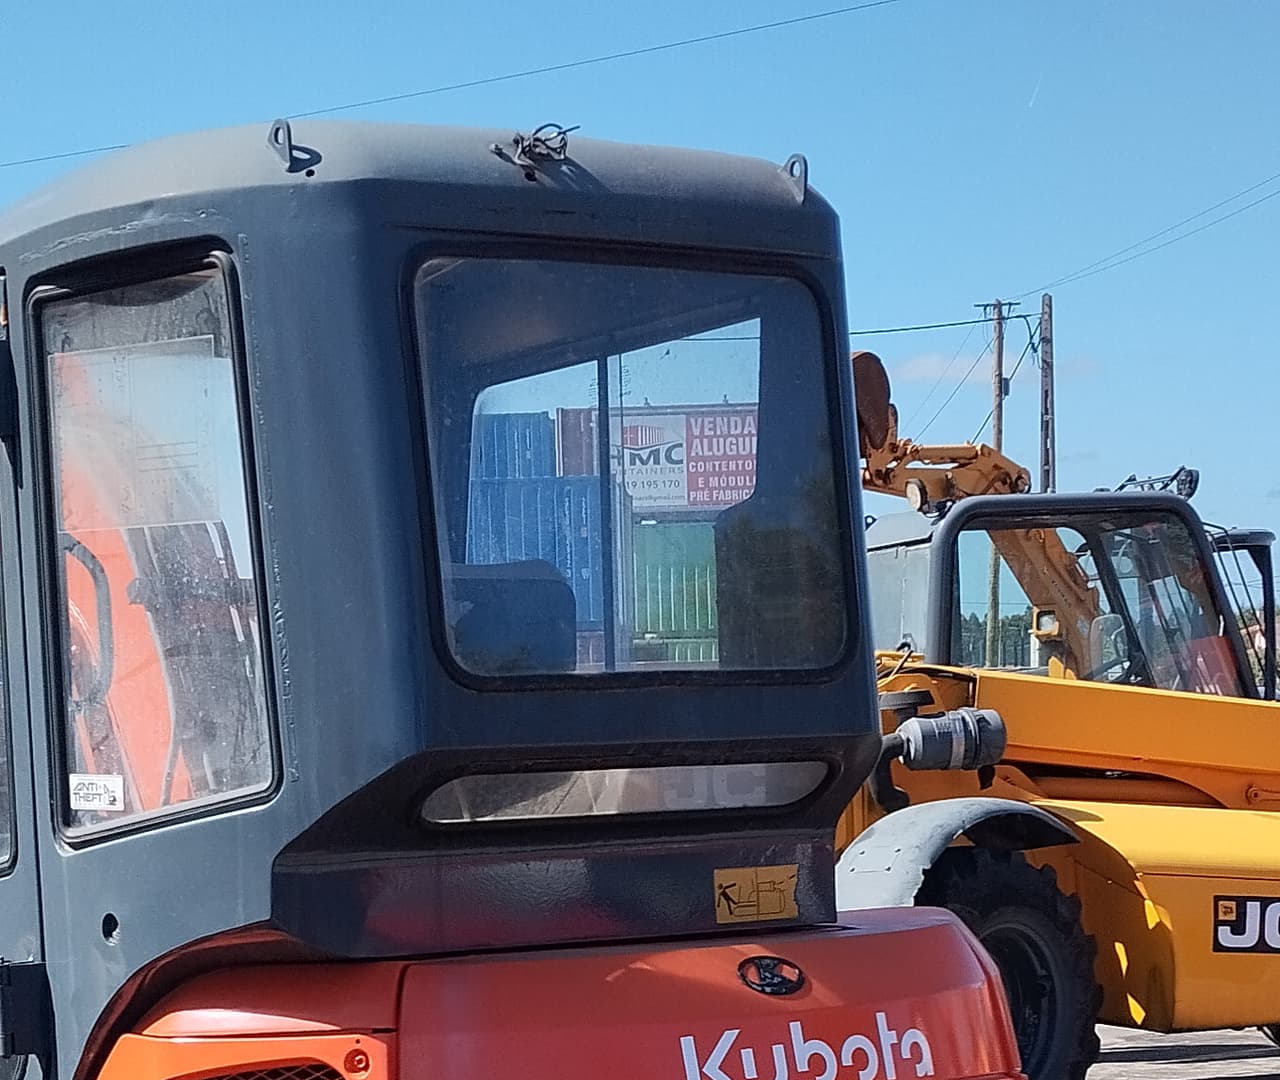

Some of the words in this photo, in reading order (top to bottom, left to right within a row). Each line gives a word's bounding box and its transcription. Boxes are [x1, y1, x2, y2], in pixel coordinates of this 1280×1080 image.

[641, 480, 658, 489] 195
[662, 480, 680, 488] 170
[698, 477, 705, 488] E
[689, 488, 710, 502] PRÉ
